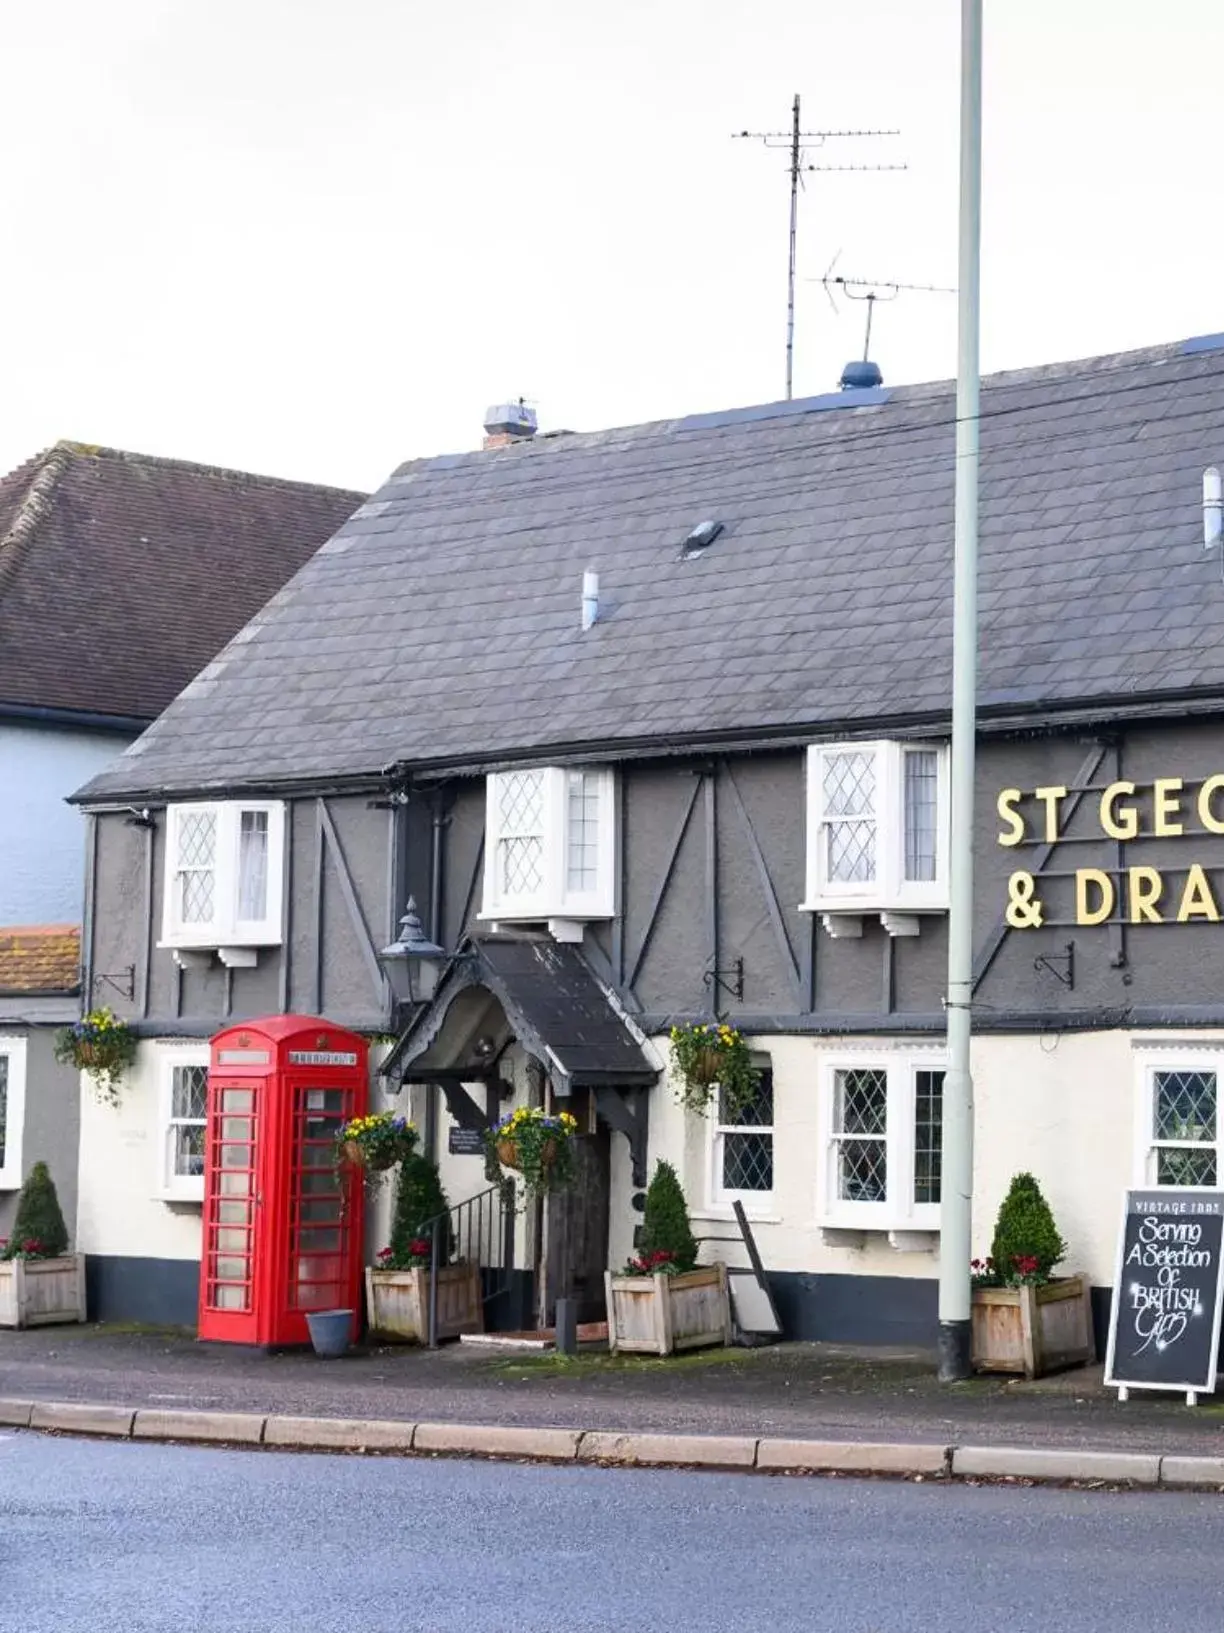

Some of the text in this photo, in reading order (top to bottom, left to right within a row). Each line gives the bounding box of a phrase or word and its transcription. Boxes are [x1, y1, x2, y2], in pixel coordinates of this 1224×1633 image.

[997, 787, 1066, 845] ST
[1005, 870, 1044, 928] &
[1136, 1201, 1186, 1215] VINTAGE
[1139, 1216, 1201, 1245] Serving
[1126, 1243, 1210, 1266] A Selection
